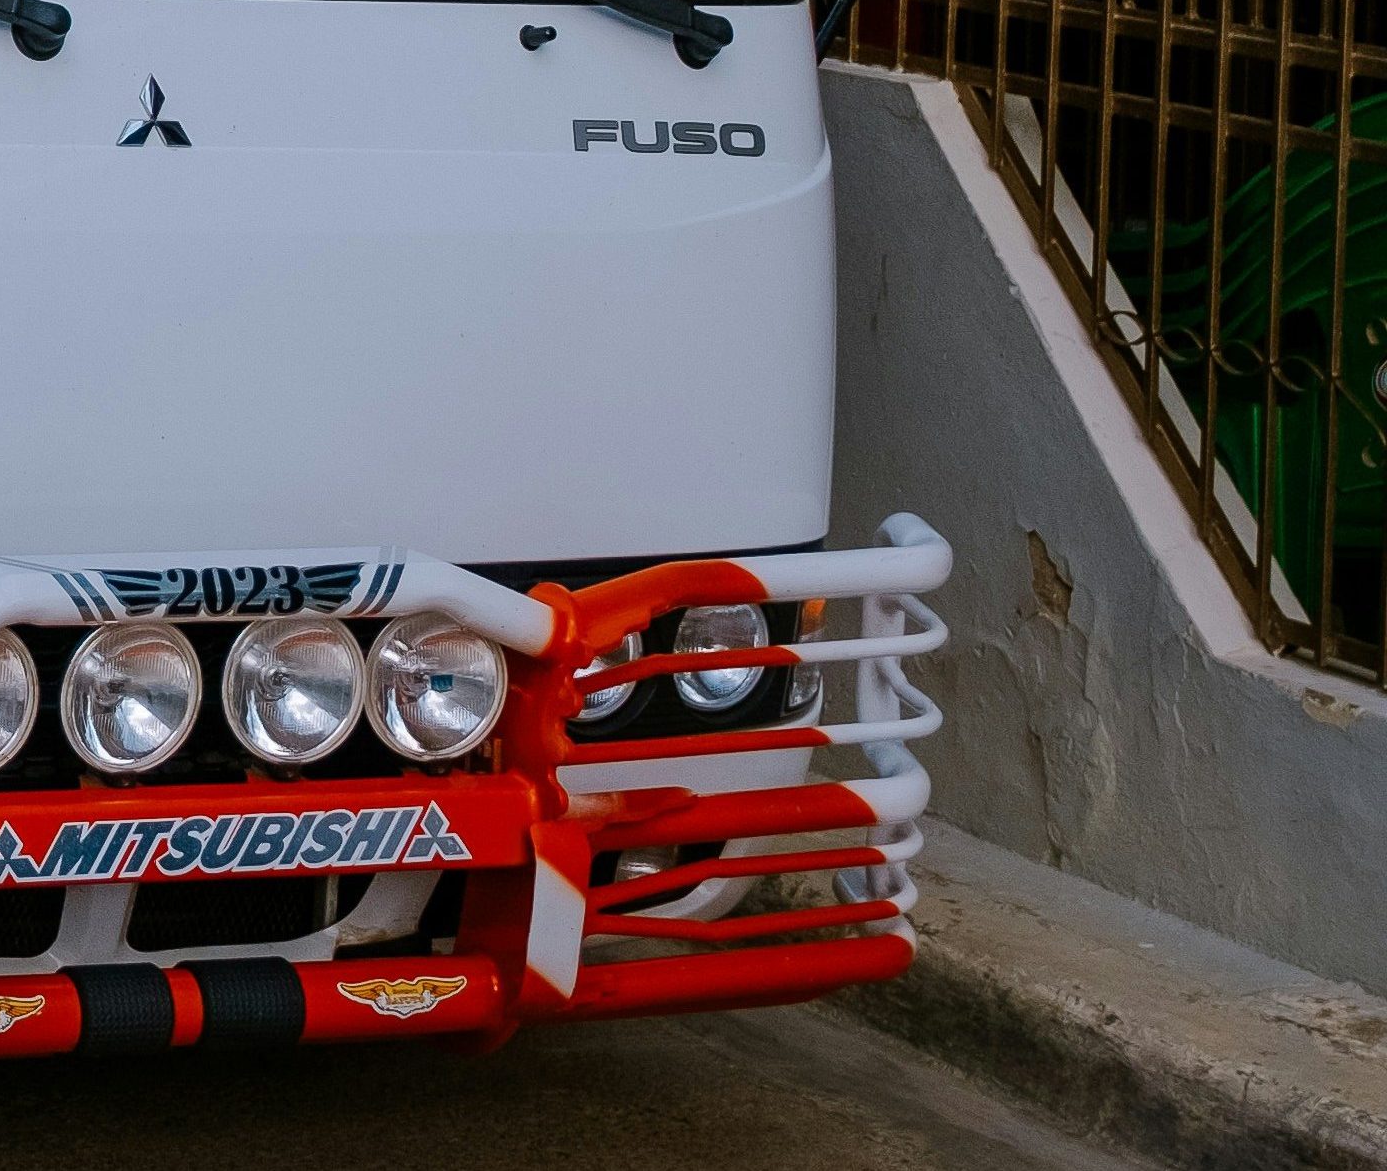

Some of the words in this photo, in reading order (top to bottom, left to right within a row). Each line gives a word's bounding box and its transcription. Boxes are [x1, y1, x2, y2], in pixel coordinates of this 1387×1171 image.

[572, 119, 767, 157] FUSO
[164, 565, 307, 616] 2023
[36, 806, 417, 883] MITSUBISHI
